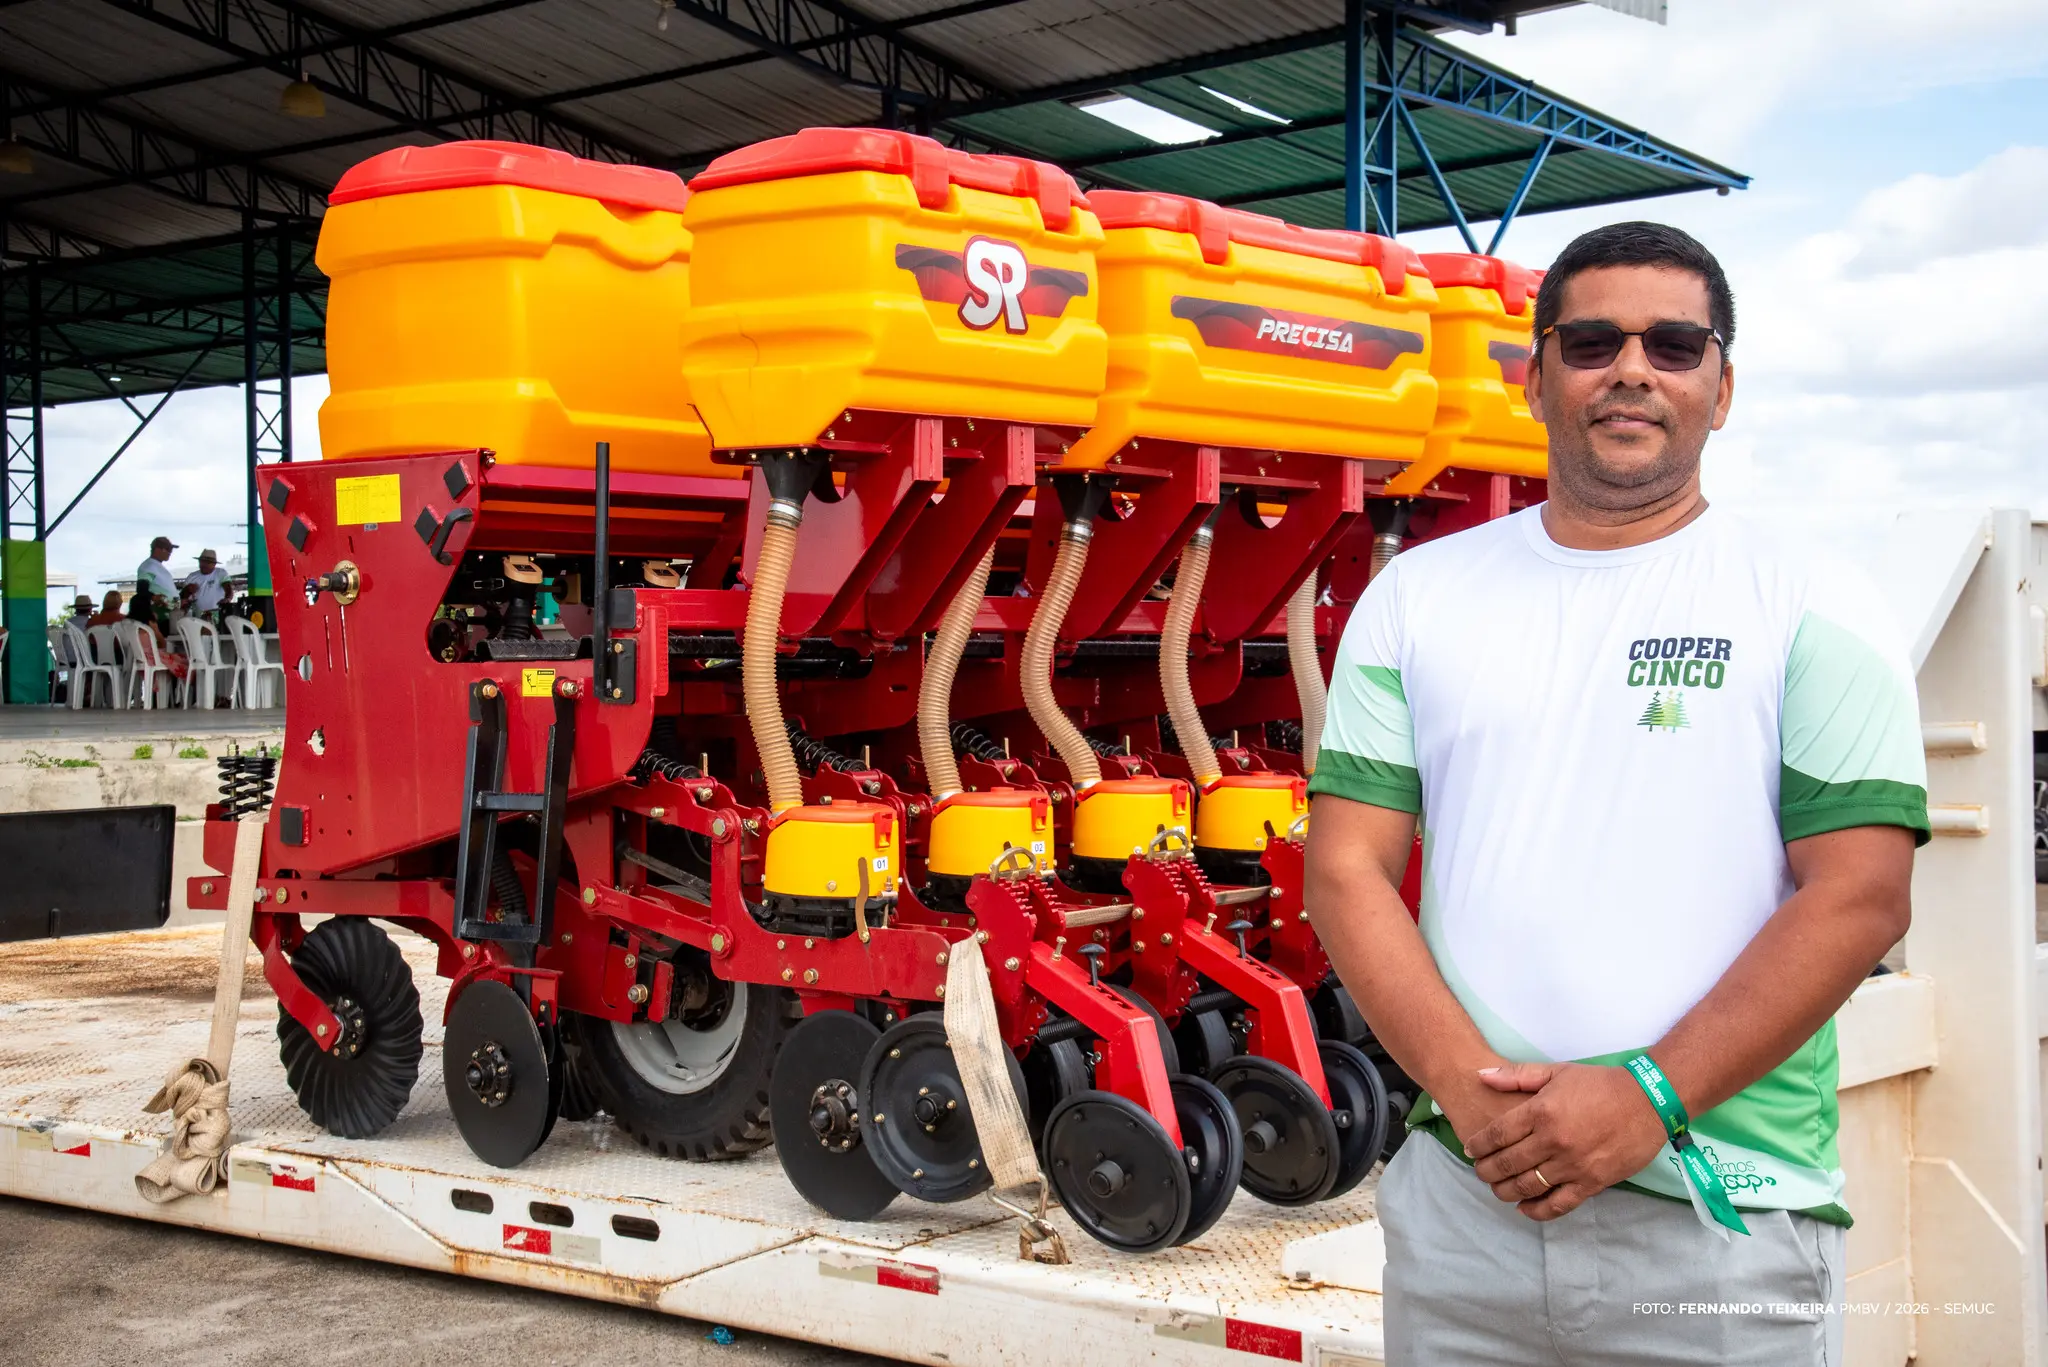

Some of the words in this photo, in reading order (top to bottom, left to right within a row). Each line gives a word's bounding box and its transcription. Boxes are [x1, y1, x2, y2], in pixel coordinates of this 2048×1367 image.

[960, 238, 1027, 332] SR
[1256, 318, 1353, 353] PRECISA
[1628, 636, 1733, 661] COOPER
[1626, 660, 1726, 690] CINCO
[1034, 843, 1044, 852] 02
[876, 859, 886, 869] 01
[1634, 1063, 1667, 1107] COOPERATIVA
[1648, 1067, 1663, 1083] DOS
[1711, 1160, 1756, 1173] omos
